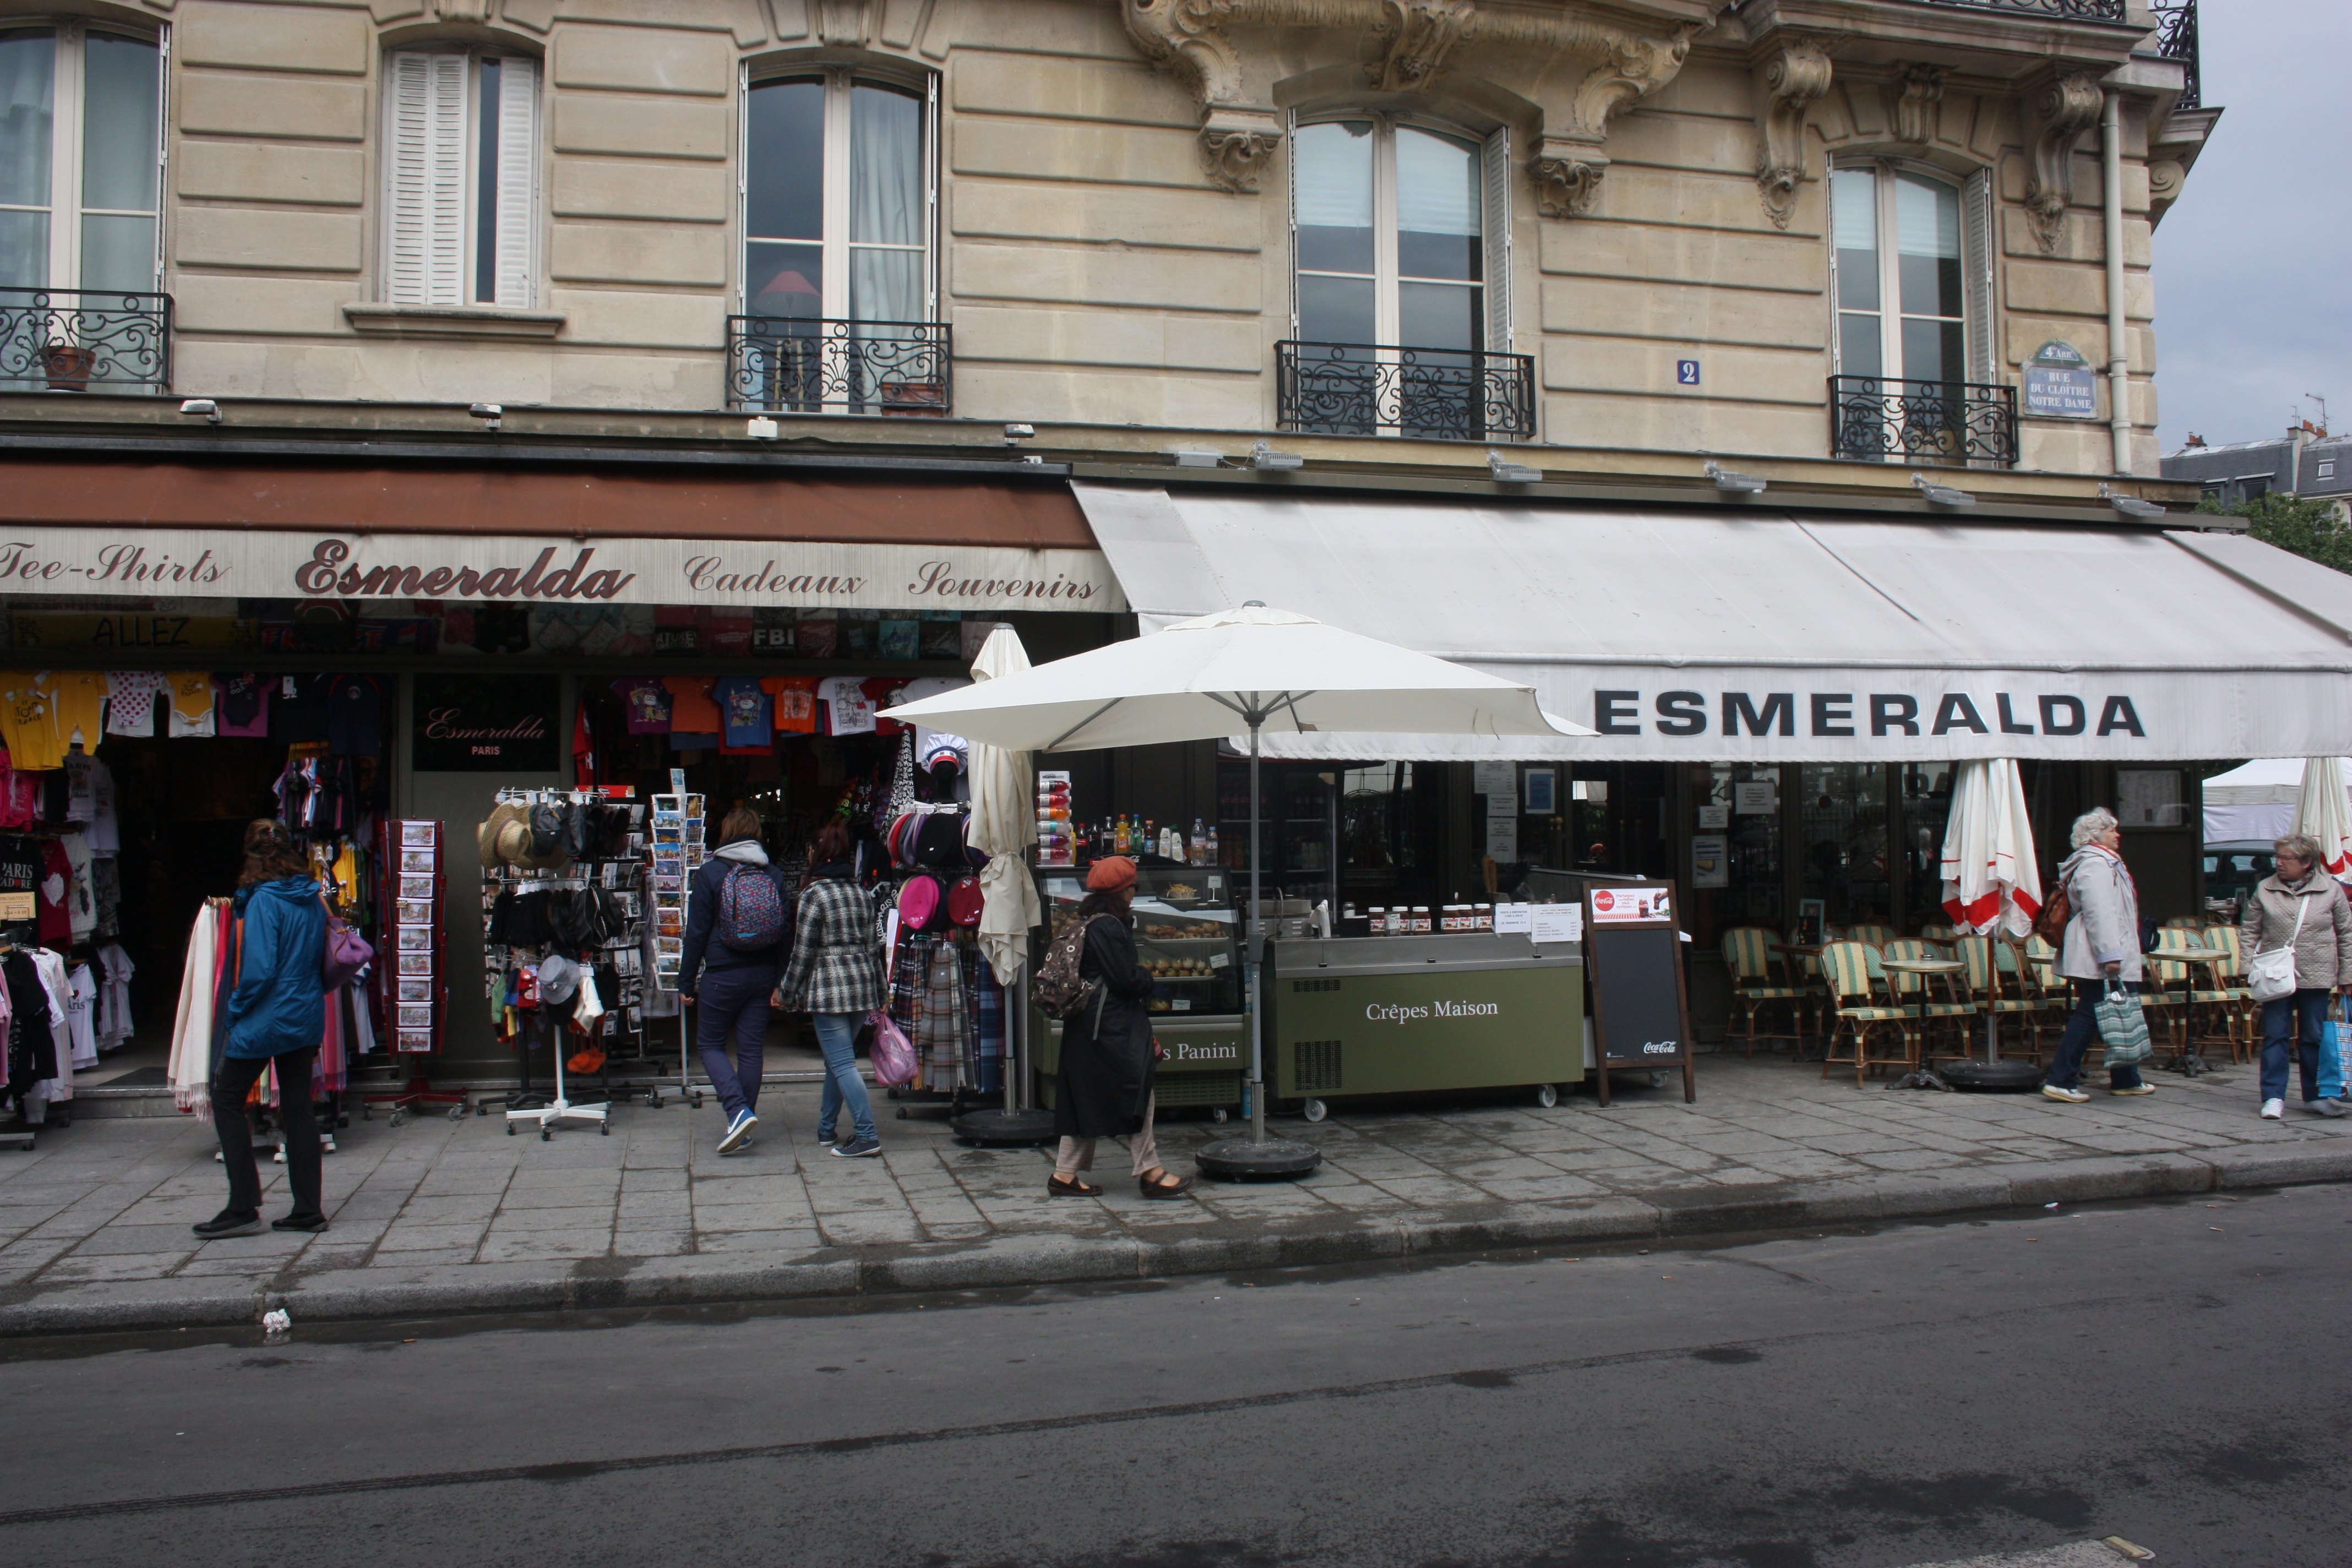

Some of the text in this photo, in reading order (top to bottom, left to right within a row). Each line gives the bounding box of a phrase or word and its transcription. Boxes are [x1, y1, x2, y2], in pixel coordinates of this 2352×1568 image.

[1683, 362, 1695, 382] 2
[2048, 372, 2070, 383] RUE
[2030, 383, 2044, 393] DU
[2029, 396, 2092, 409] NOTRE DAME
[0, 539, 1103, 600] Tee-Shirts Esmeralda Cadeaux Souvenirs
[91, 616, 190, 648] ALLEZ
[753, 628, 795, 646] FBI
[1593, 689, 2146, 738] ESMERALDA
[425, 707, 545, 739] Esmeralda
[472, 746, 500, 755] PARIS
[1366, 1000, 1499, 1024] Crêpes Maison
[1177, 1042, 1237, 1060] Panini
[1643, 1041, 1677, 1054] Coca-Cola
